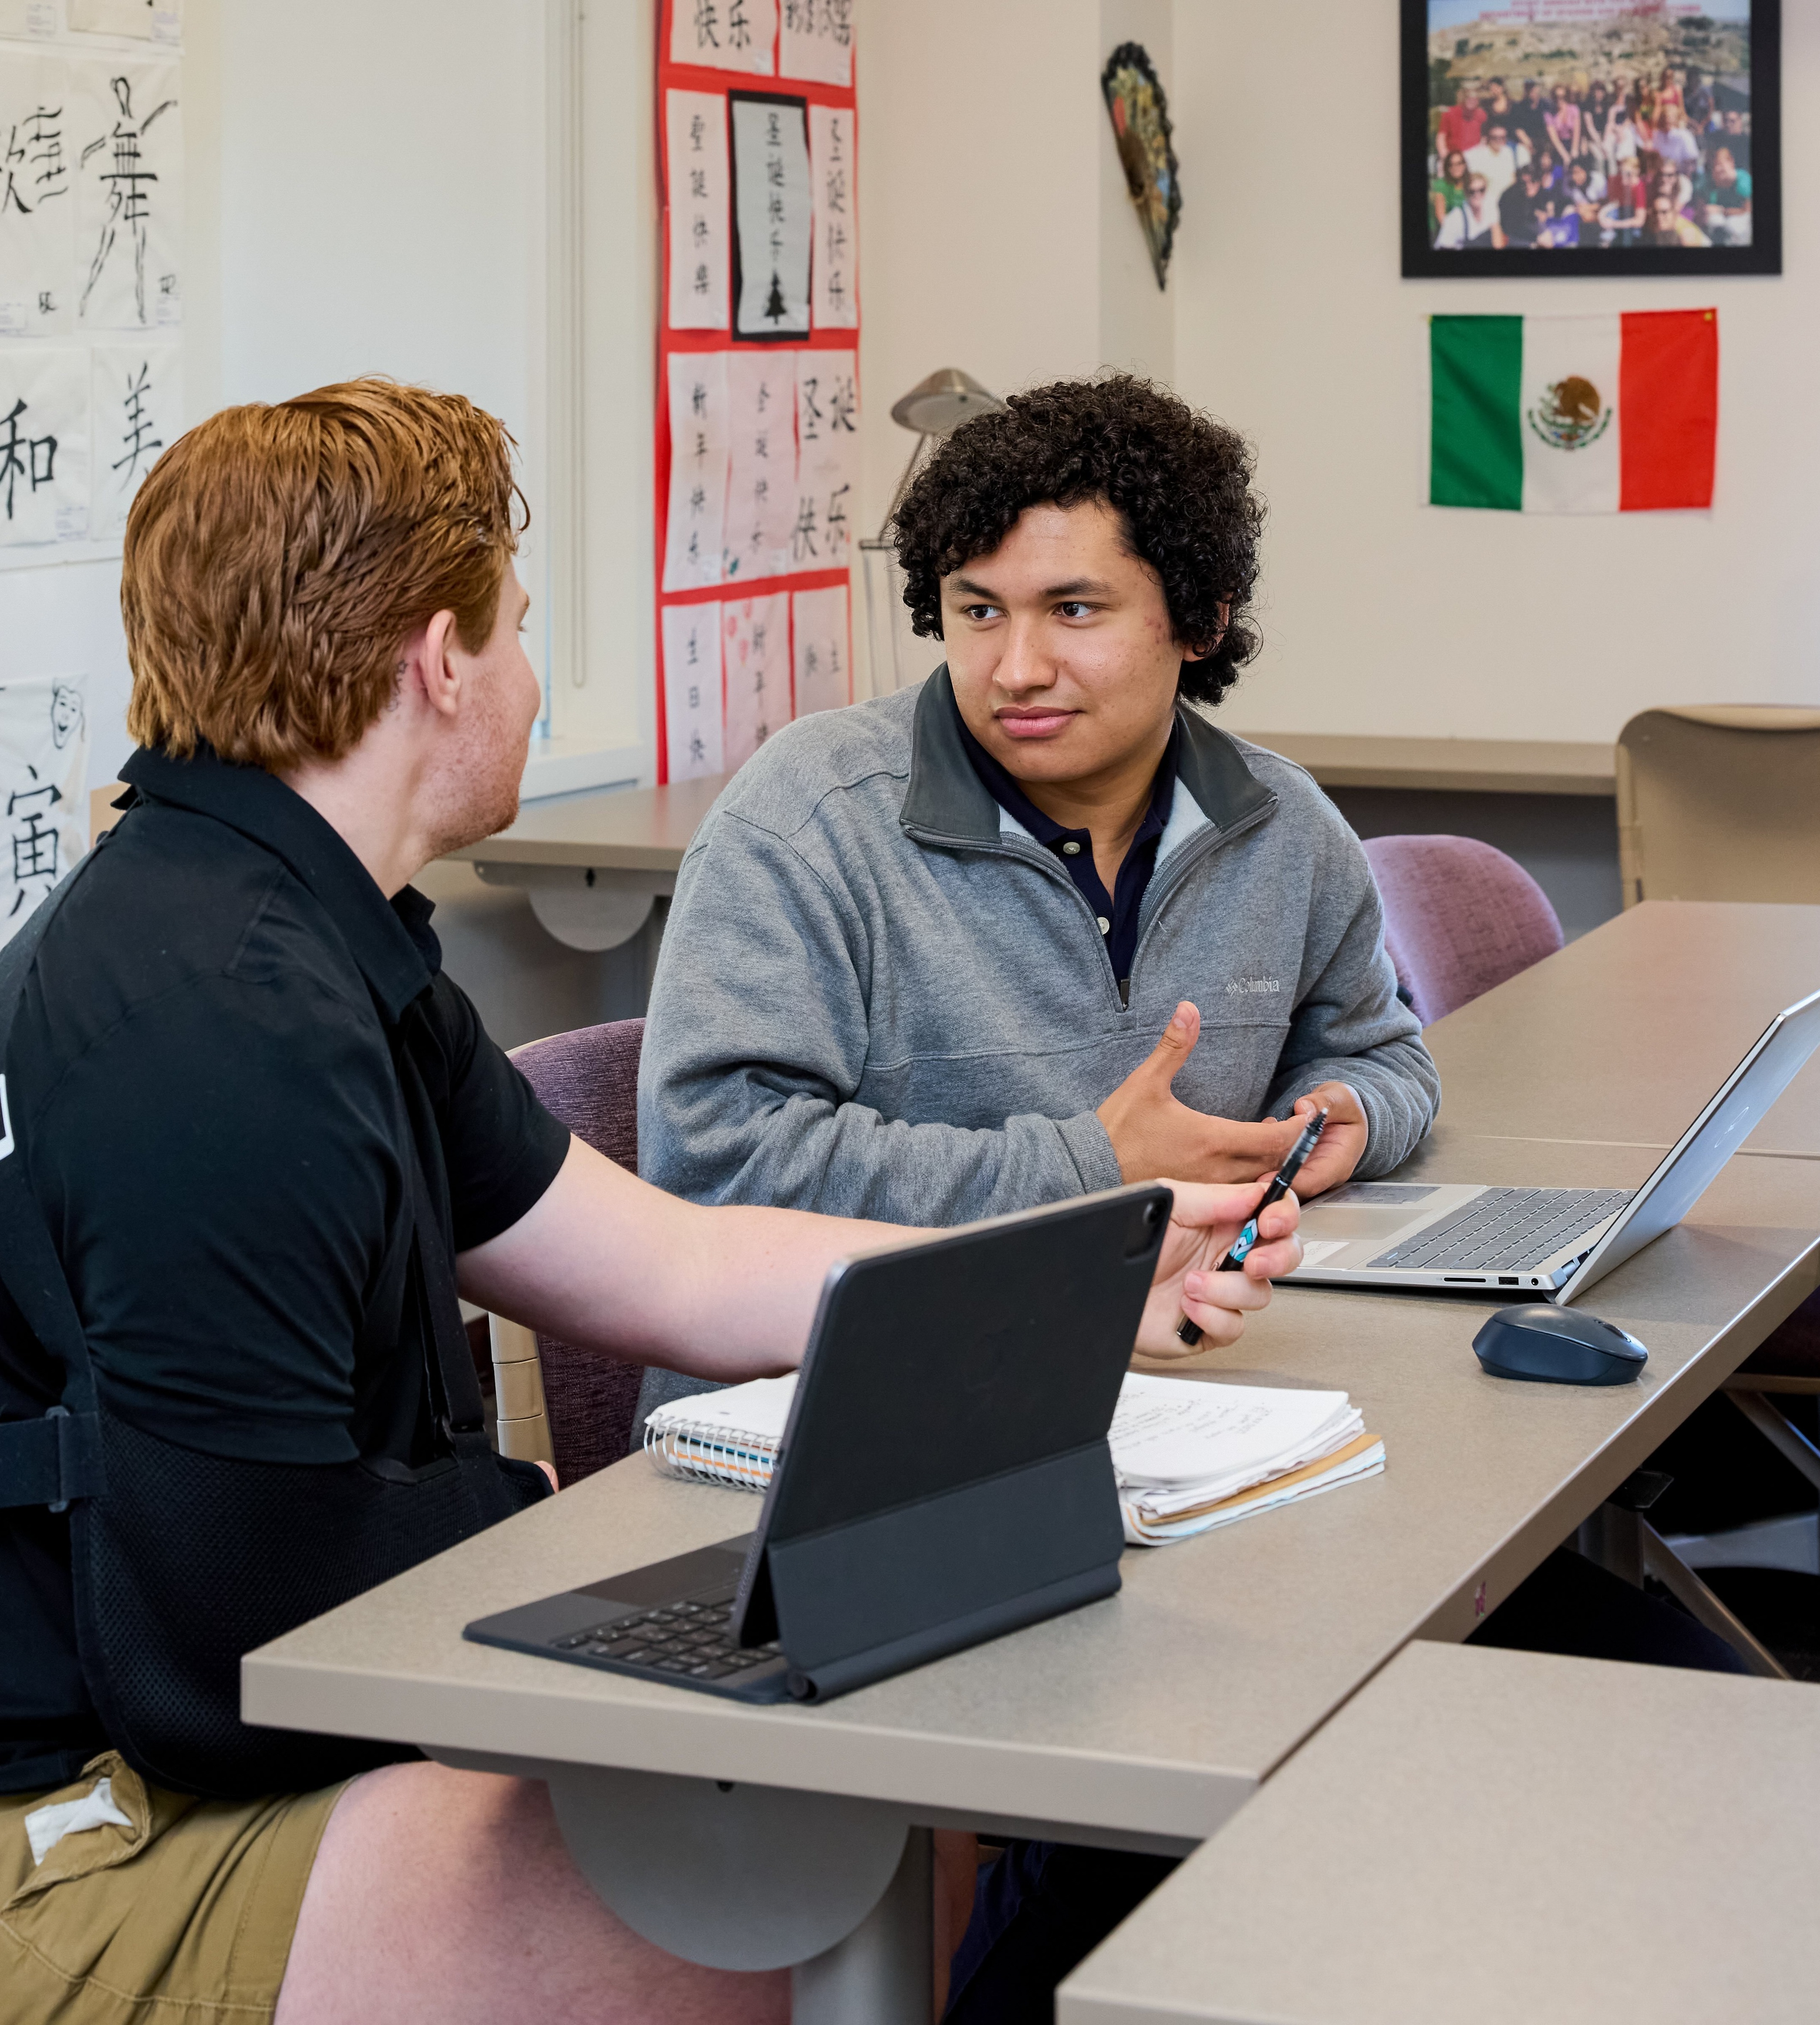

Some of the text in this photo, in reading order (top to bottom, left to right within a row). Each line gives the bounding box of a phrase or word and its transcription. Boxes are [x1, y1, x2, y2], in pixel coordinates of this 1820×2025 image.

[0, 398, 58, 520] 和
[113, 361, 163, 492] 美
[7, 764, 62, 917] 寅
[1238, 975, 1280, 993] Columbia
